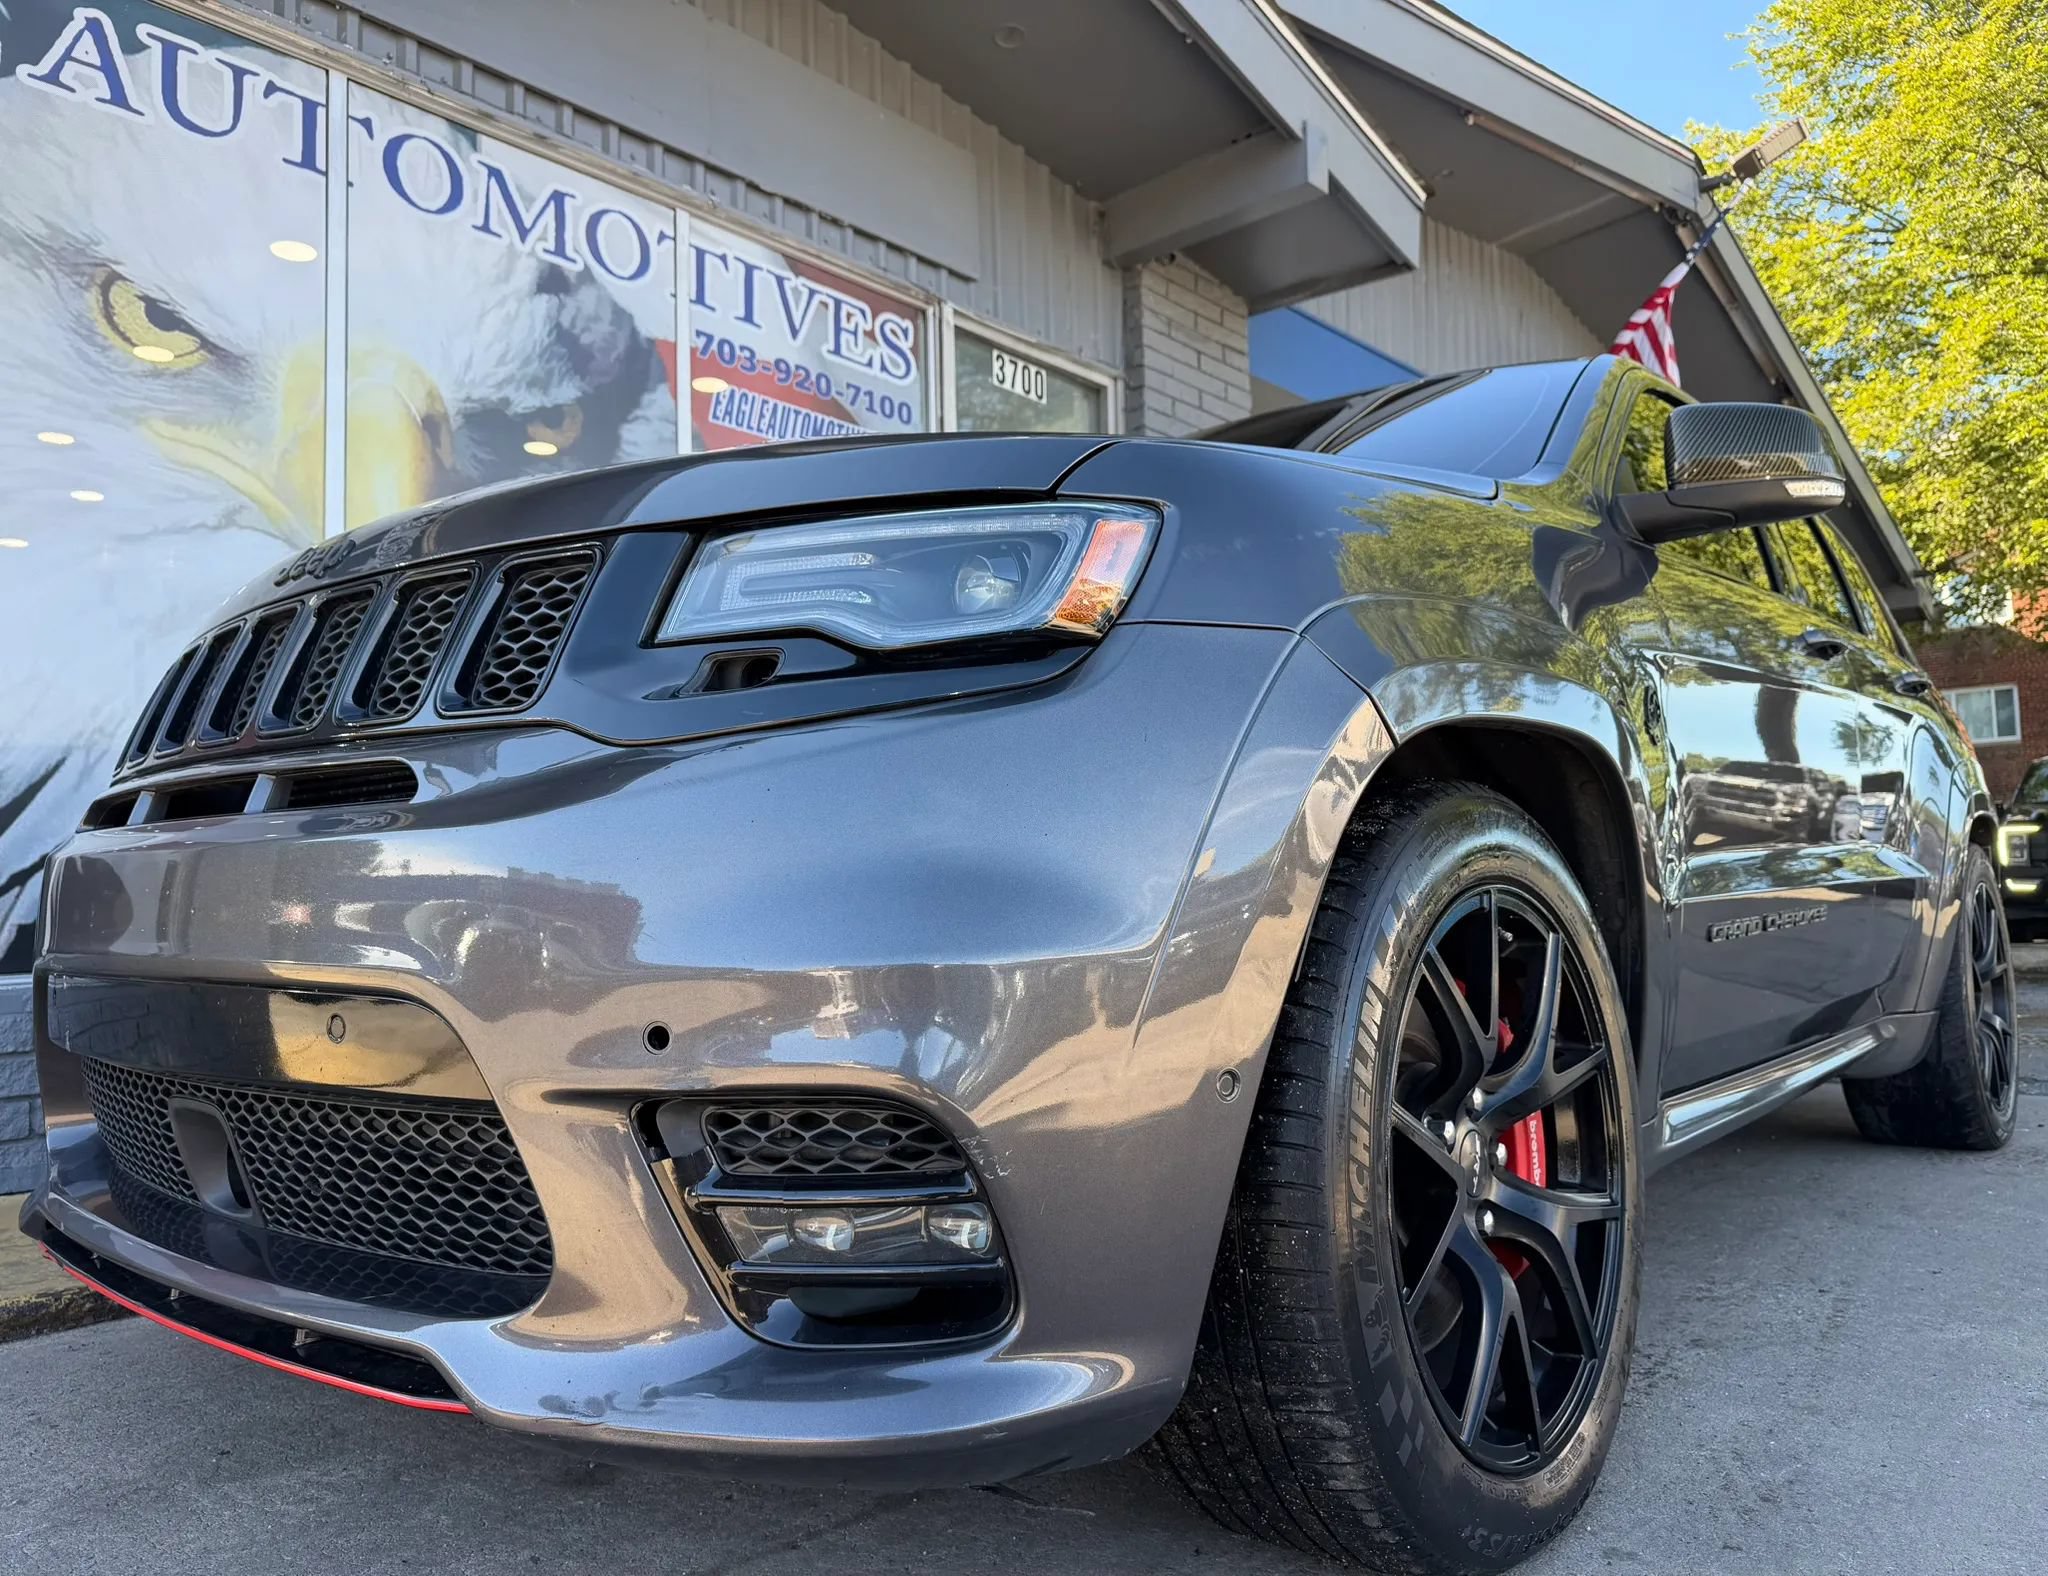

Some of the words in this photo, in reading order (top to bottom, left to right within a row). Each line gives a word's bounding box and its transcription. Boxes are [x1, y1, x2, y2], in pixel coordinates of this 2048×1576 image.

[26, 16, 914, 379] AUTOMOTIVES
[695, 329, 913, 426] 703-920-7100
[996, 354, 1044, 400] 3700
[1348, 977, 1388, 1284] MICHELIN
